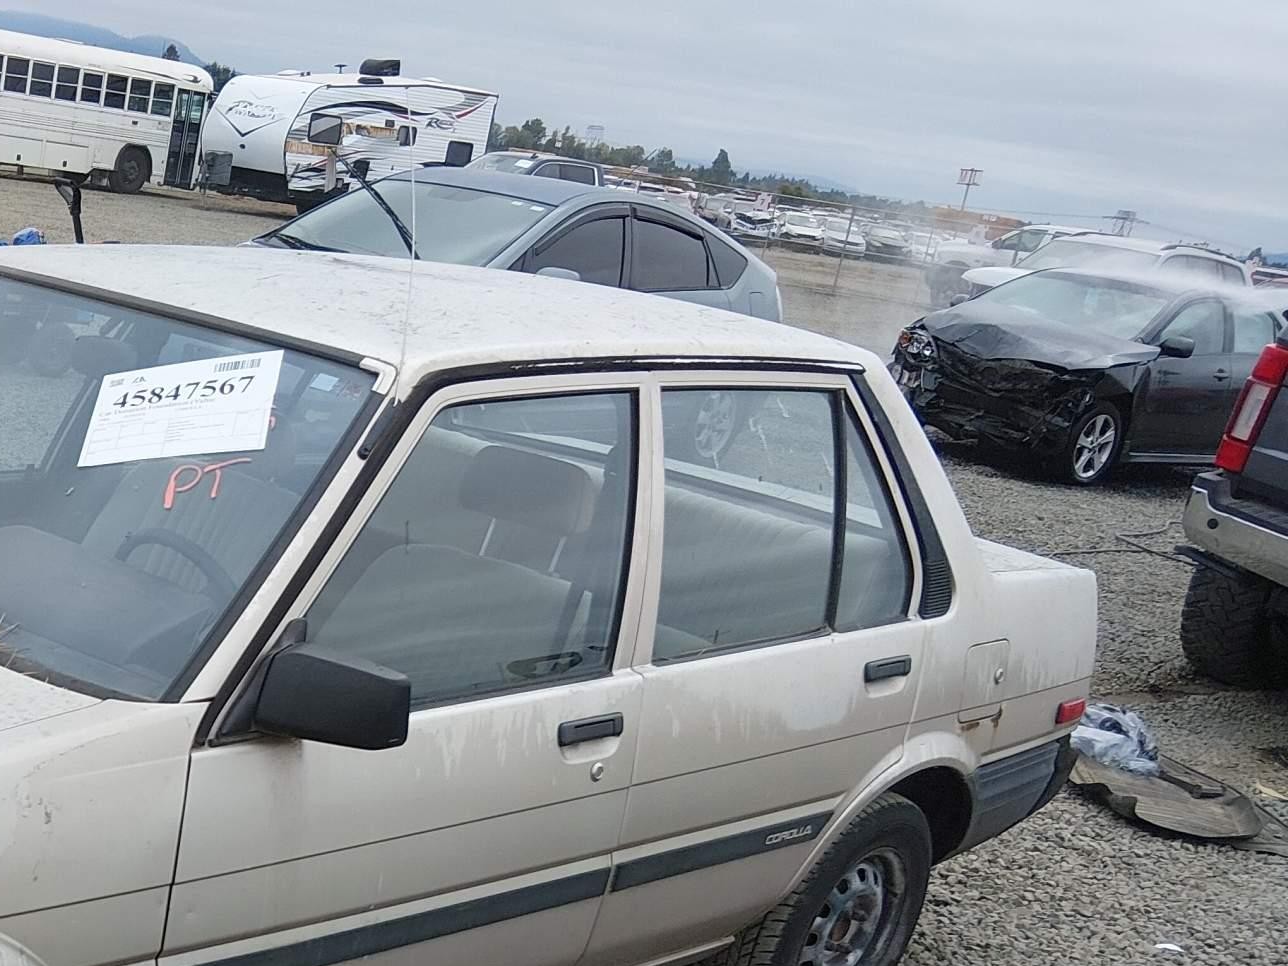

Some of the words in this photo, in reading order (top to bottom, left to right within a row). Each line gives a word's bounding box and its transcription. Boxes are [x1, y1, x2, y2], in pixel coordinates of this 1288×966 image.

[113, 376, 255, 408] 45847567
[163, 457, 253, 510] PT
[765, 824, 812, 845] COROLLA
